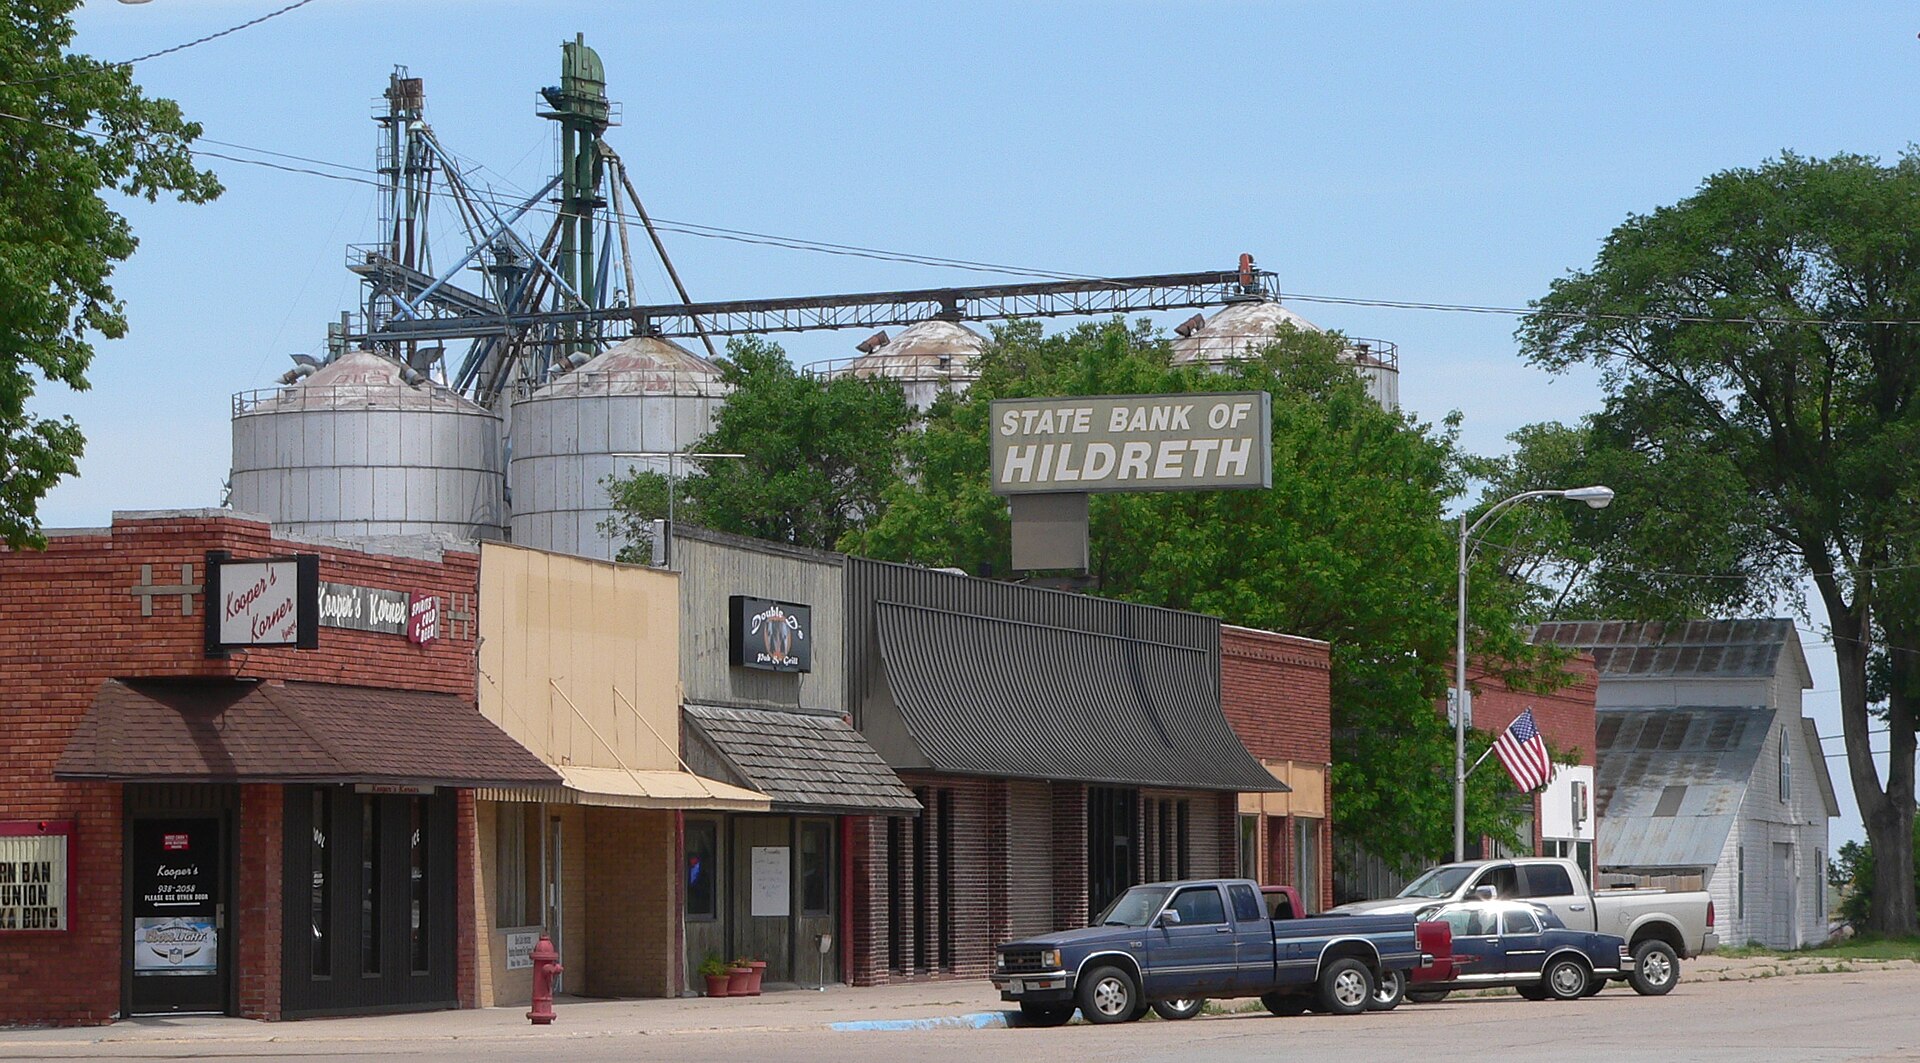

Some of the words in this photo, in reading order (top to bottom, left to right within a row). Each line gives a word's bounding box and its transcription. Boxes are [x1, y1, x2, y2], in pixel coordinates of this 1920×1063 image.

[1000, 408, 1093, 436] STATE
[1108, 405, 1194, 432] BANK
[1208, 403, 1252, 430] OF
[1001, 438, 1252, 483] HILDRETH
[226, 562, 277, 622] Kooper's
[369, 593, 406, 625] Korner
[411, 596, 433, 617] SPIRITS
[251, 597, 293, 643] Korner
[421, 608, 435, 627] COLD
[751, 606, 784, 635] Double
[420, 624, 434, 643] BEER
[757, 653, 771, 663] Pub
[783, 656, 798, 666] Grill
[22, 862, 50, 883] BAN
[157, 864, 198, 880] Kooper's
[144, 894, 163, 902] PLEASE
[177, 893, 193, 901] OTHER
[157, 884, 196, 893] 938-2058
[22, 907, 58, 929] BOYS
